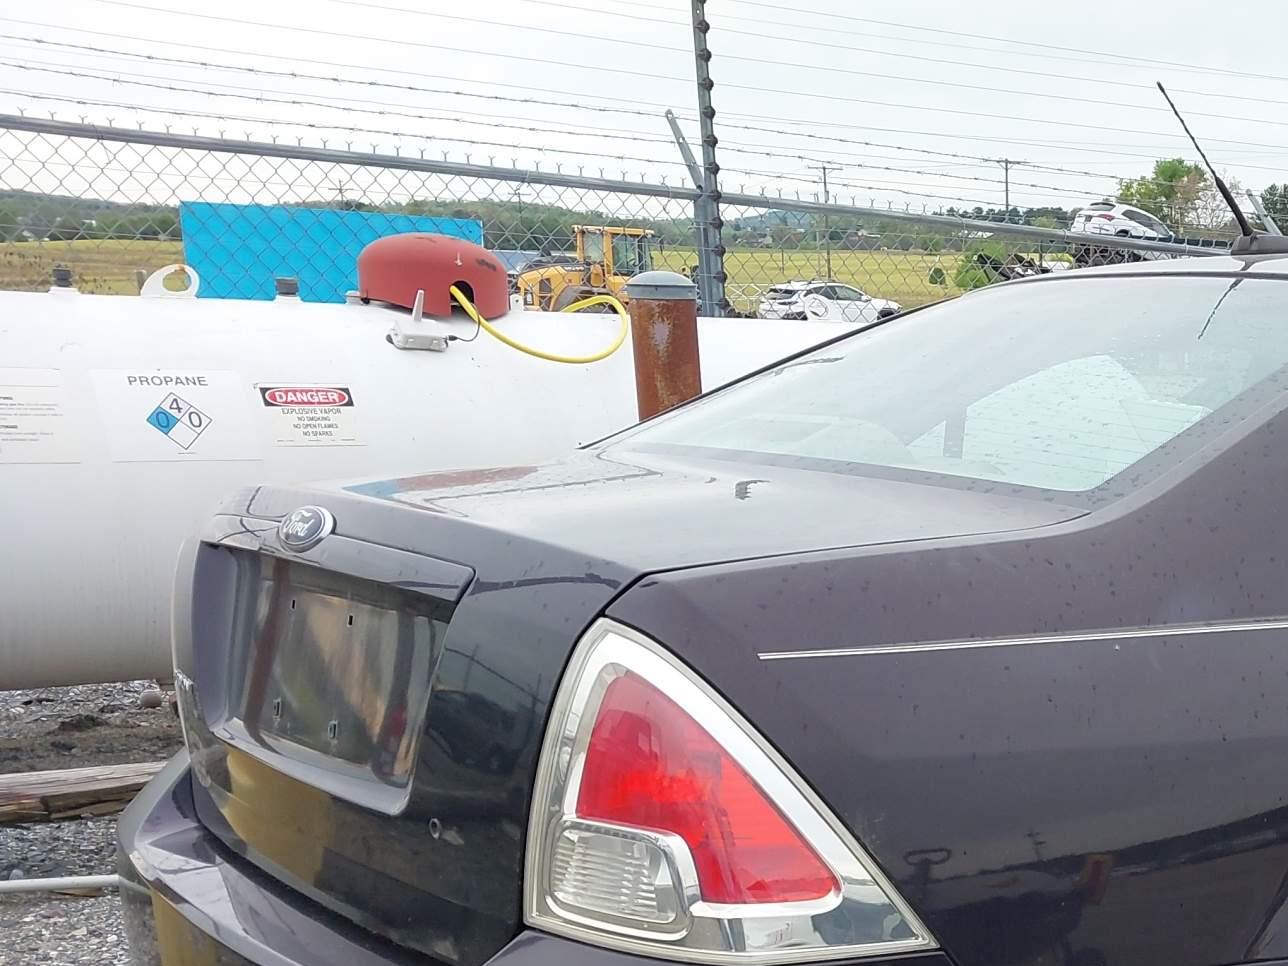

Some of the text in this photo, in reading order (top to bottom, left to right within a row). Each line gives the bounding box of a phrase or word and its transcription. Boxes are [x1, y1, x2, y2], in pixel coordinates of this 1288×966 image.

[126, 375, 209, 387] PROPANE
[274, 390, 341, 403] DANGER
[168, 397, 184, 414] 4
[281, 407, 342, 415] EXPLOSIVE VAPOR
[155, 411, 170, 428] 0
[188, 411, 202, 428] 0
[282, 510, 315, 536] Ford
